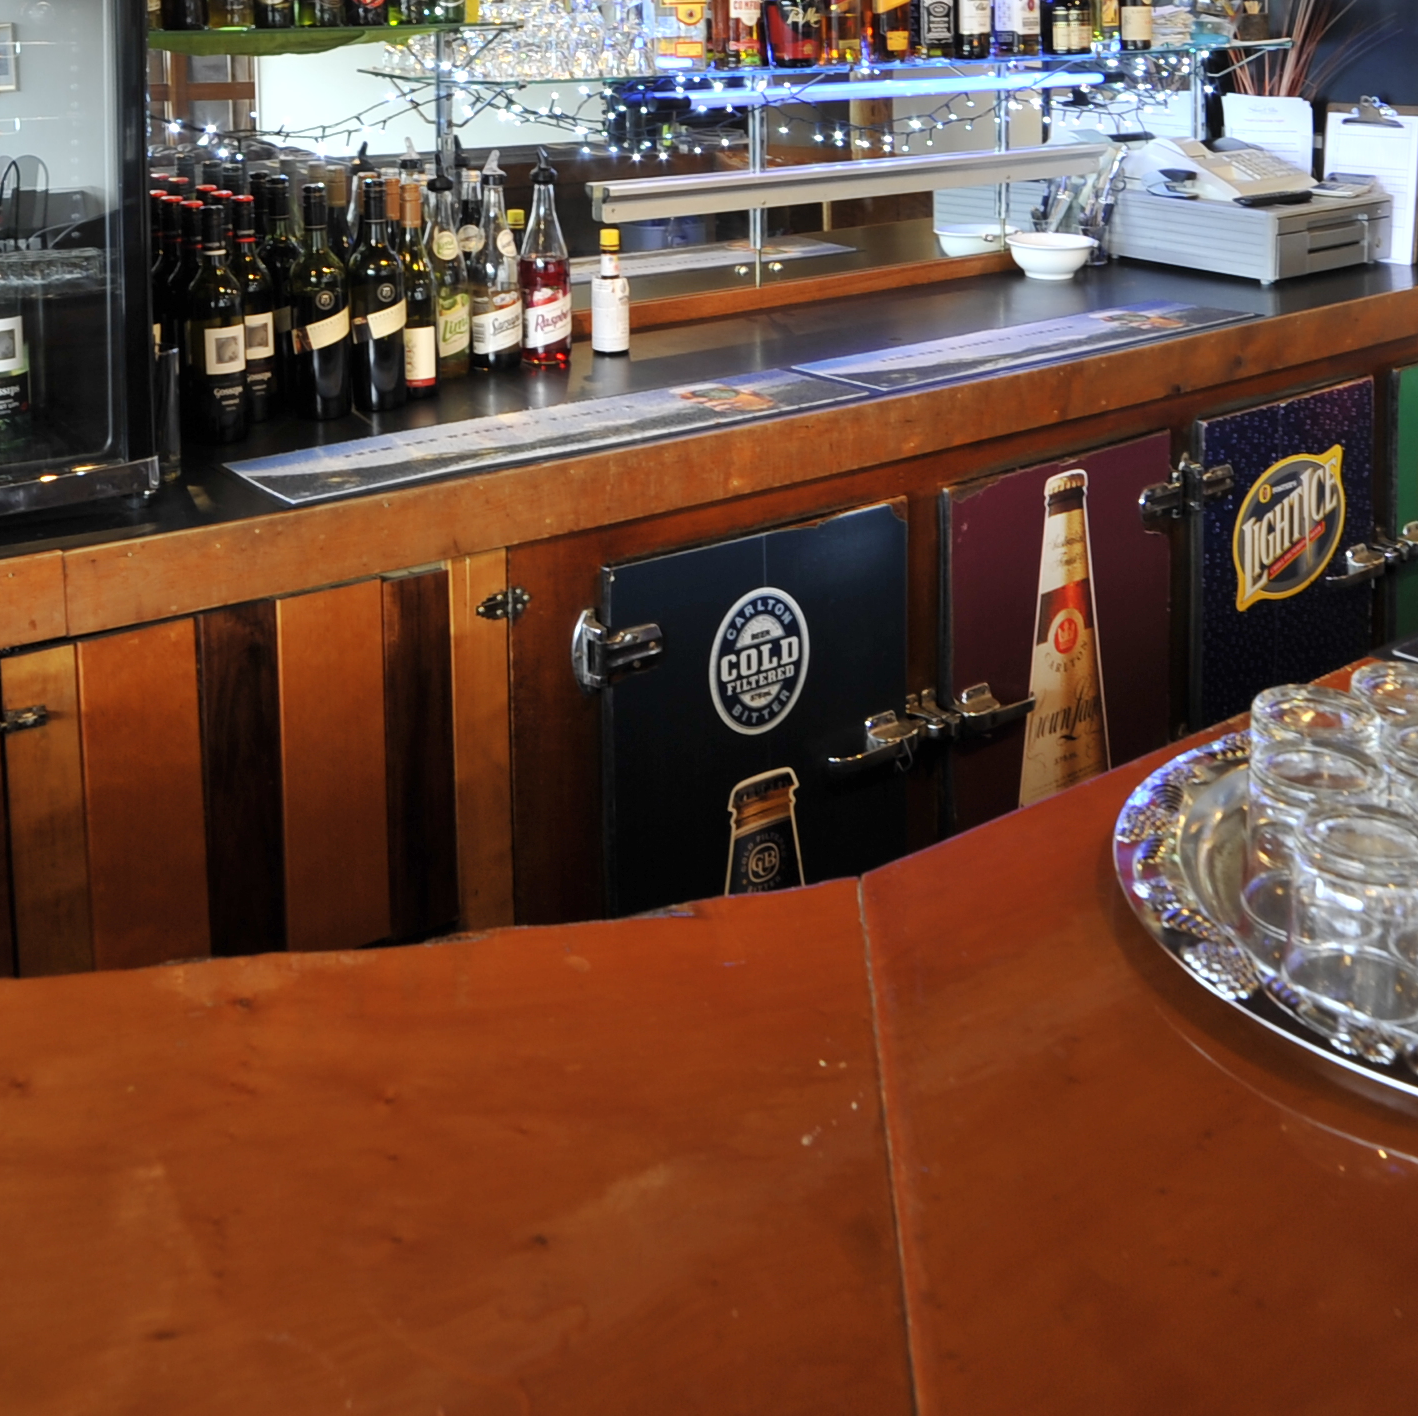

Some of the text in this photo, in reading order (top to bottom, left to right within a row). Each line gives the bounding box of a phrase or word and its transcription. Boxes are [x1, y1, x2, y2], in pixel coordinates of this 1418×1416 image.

[1242, 486, 1303, 601] LIGHT
[1300, 457, 1338, 567] ICE
[726, 598, 794, 641] CARLTON
[751, 629, 771, 641] BEER
[720, 635, 799, 682] COLD
[1044, 640, 1087, 673] CARLTON
[726, 664, 795, 696] FILTERED
[731, 689, 791, 724] BITTER
